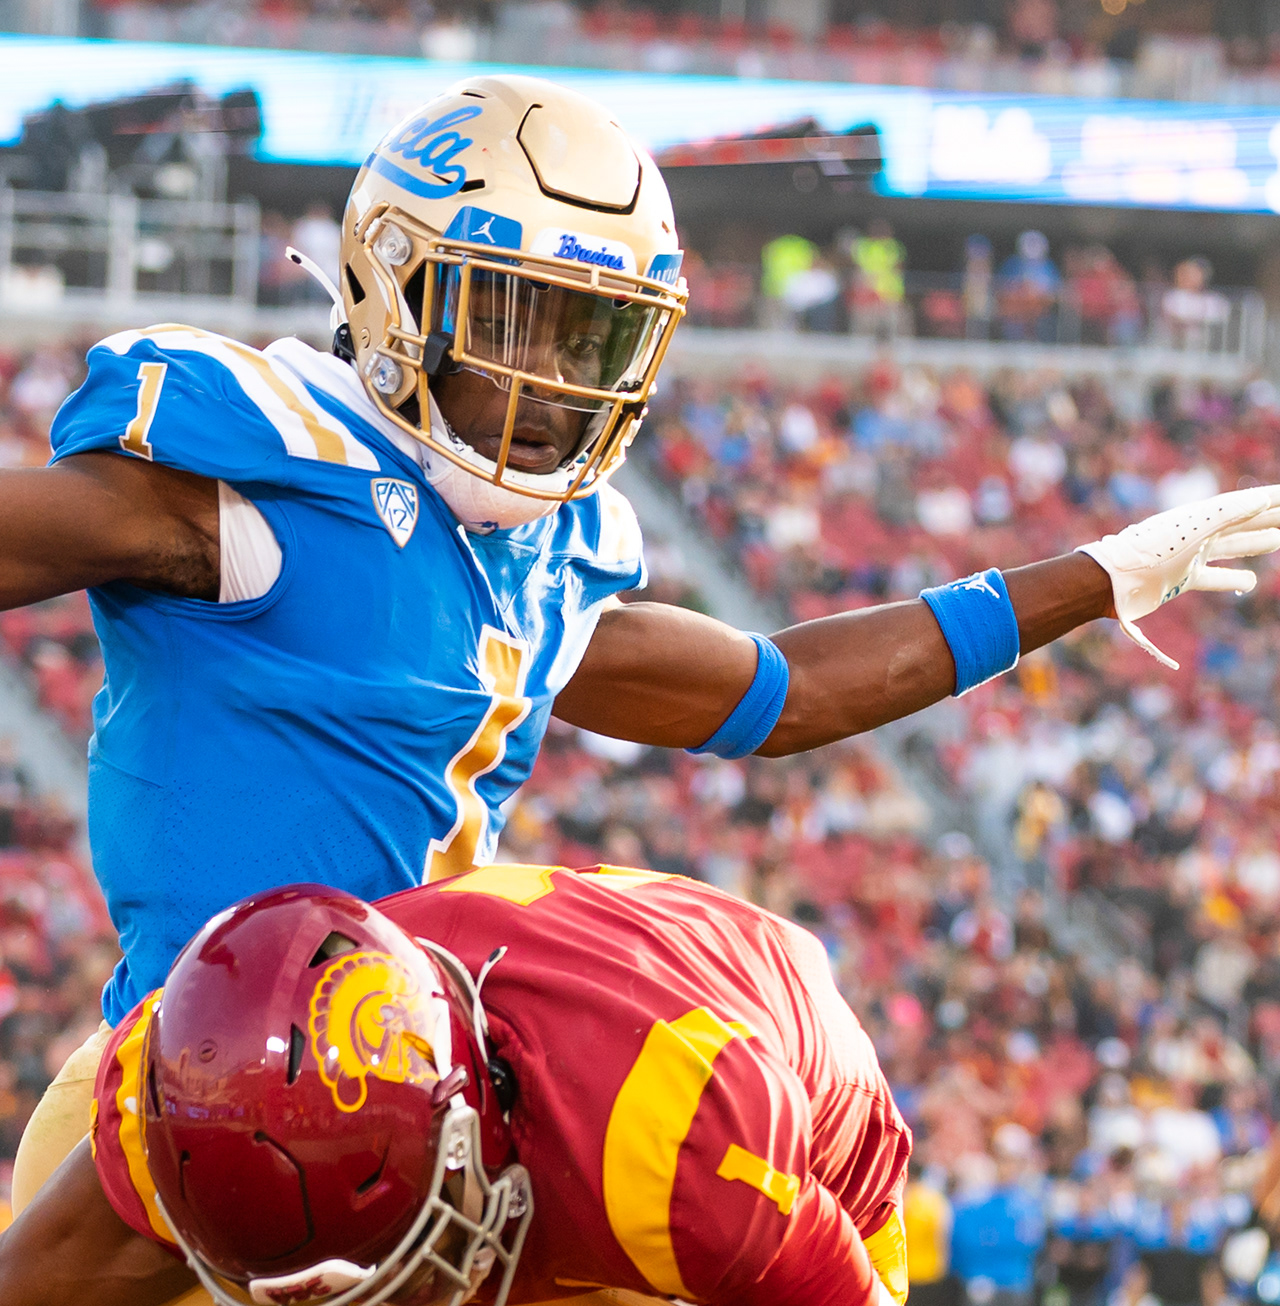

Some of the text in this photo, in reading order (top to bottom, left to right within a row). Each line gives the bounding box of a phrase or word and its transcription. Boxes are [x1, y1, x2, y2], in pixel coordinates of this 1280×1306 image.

[553, 233, 627, 271] Bruins
[118, 361, 169, 463] 1
[375, 482, 417, 521] PAC
[387, 507, 410, 533] 12
[422, 624, 534, 884] 1
[715, 1141, 801, 1217] 1
